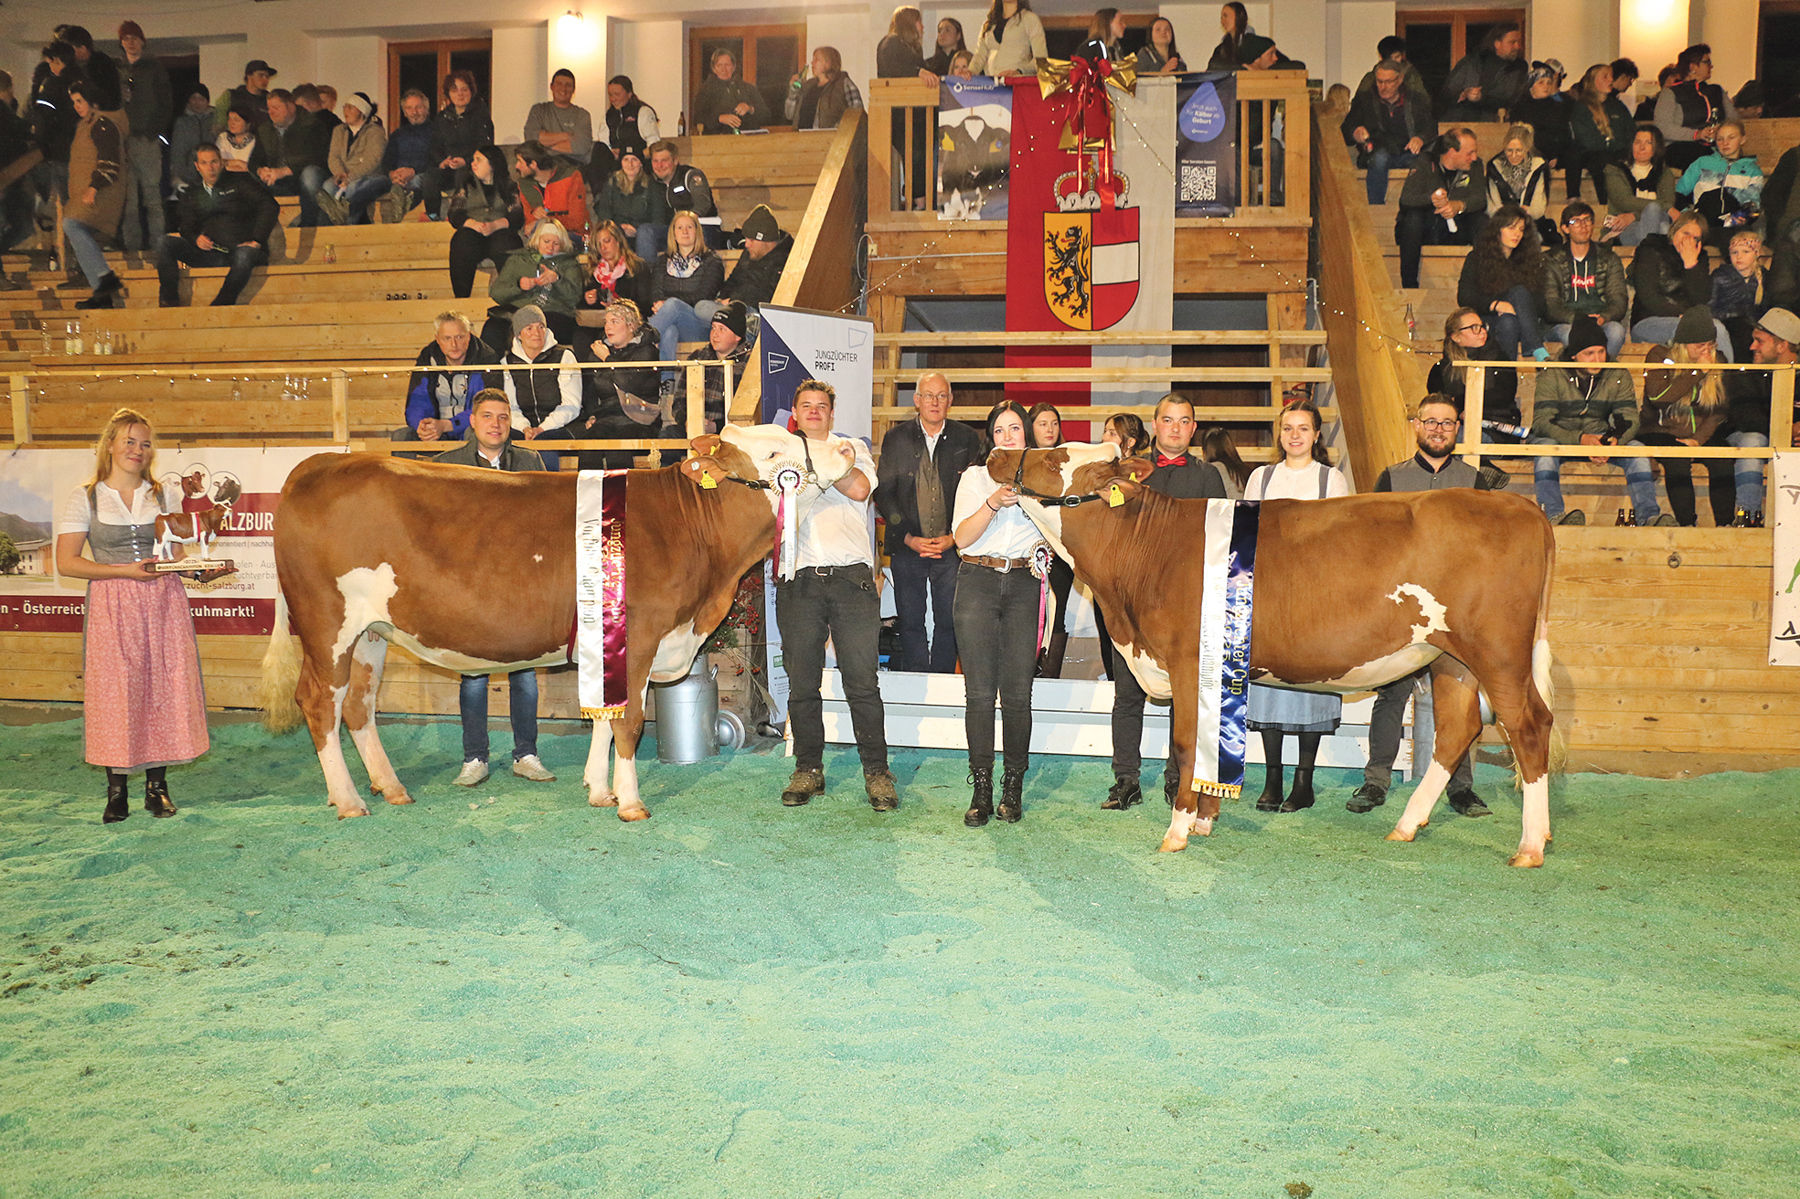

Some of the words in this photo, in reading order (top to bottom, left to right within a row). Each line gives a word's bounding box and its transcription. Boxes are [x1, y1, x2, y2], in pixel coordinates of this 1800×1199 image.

[814, 361, 835, 371] PROFI
[219, 512, 274, 531] ALZBUR
[1226, 668, 1248, 696] Cup
